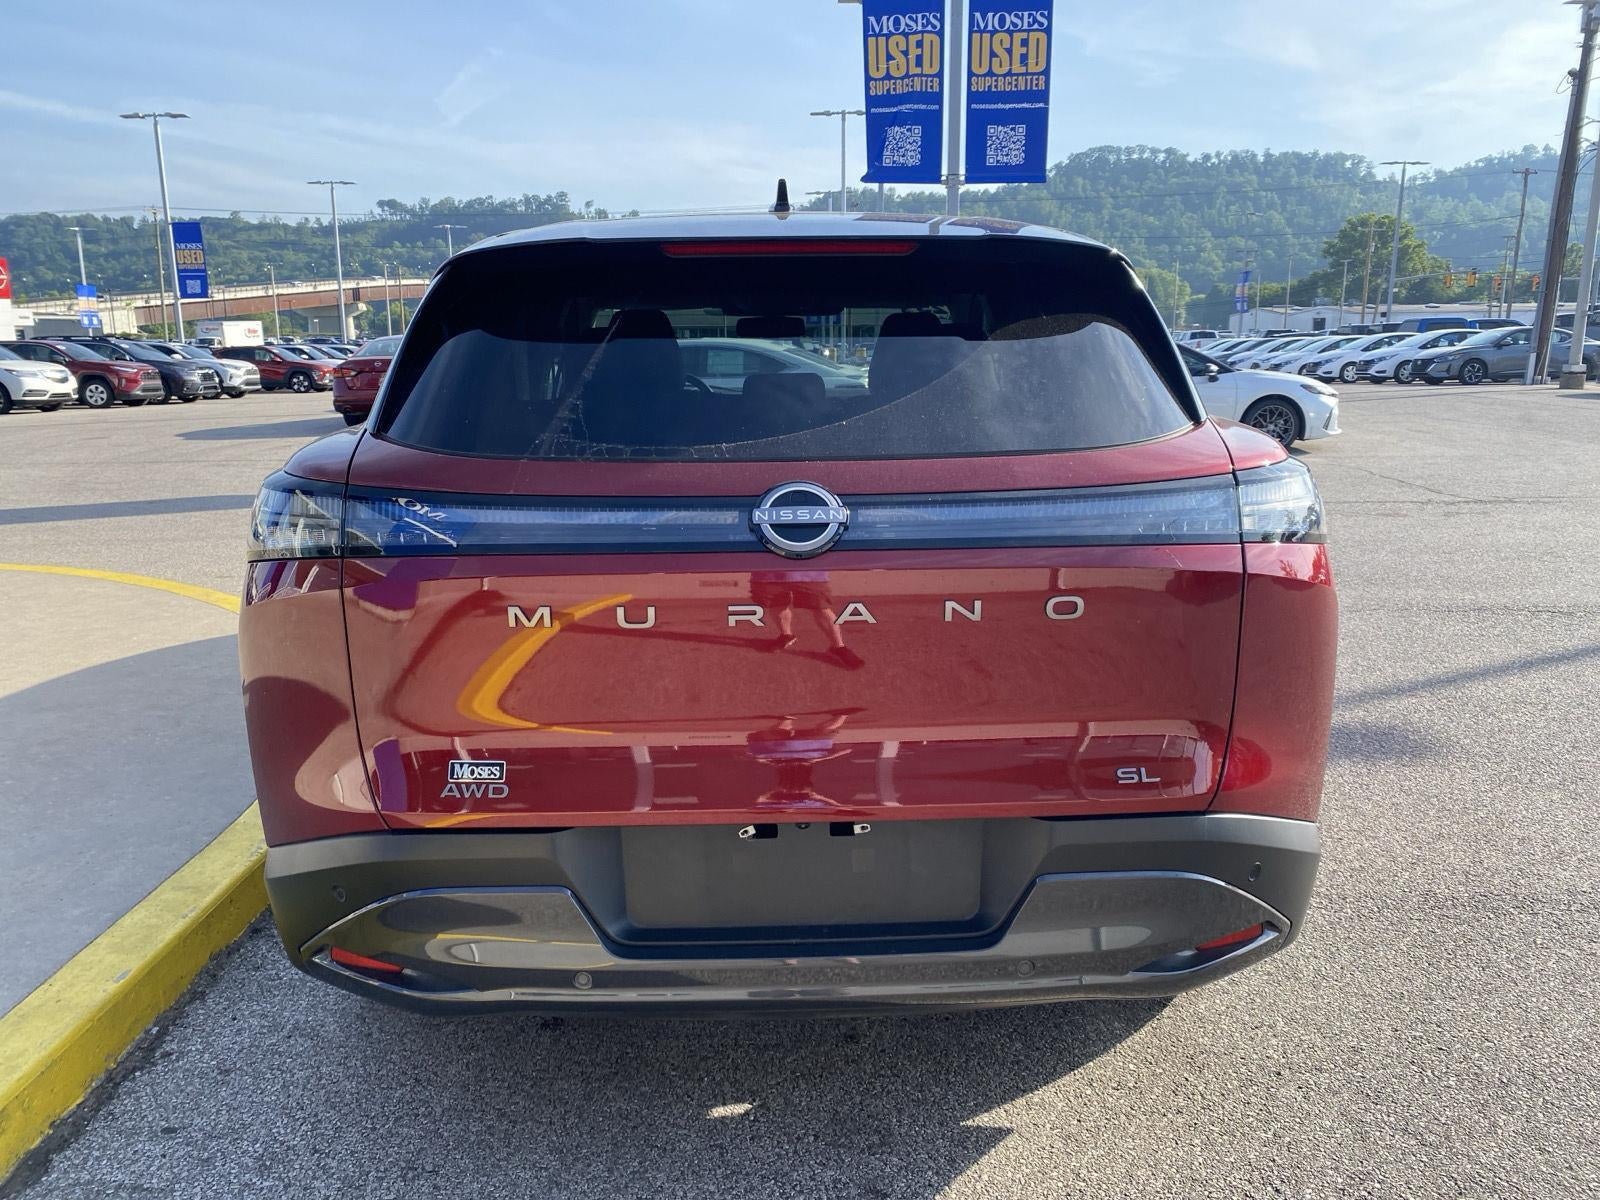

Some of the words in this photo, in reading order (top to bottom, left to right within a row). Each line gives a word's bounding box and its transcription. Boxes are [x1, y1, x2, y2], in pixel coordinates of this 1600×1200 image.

[867, 12, 941, 34] MOSES
[973, 10, 1048, 31] MOSES
[867, 33, 940, 79] USED
[971, 31, 1048, 75] USED
[869, 77, 940, 96] SUPERCENTER
[971, 75, 1046, 92] SUPERCENTER
[175, 242, 203, 250] MOSES
[176, 250, 205, 264] USED
[754, 509, 844, 521] NISSAN
[507, 595, 1086, 630] MURANO
[453, 763, 501, 779] MOSES
[1115, 767, 1161, 784] SL
[440, 783, 509, 799] AWD
